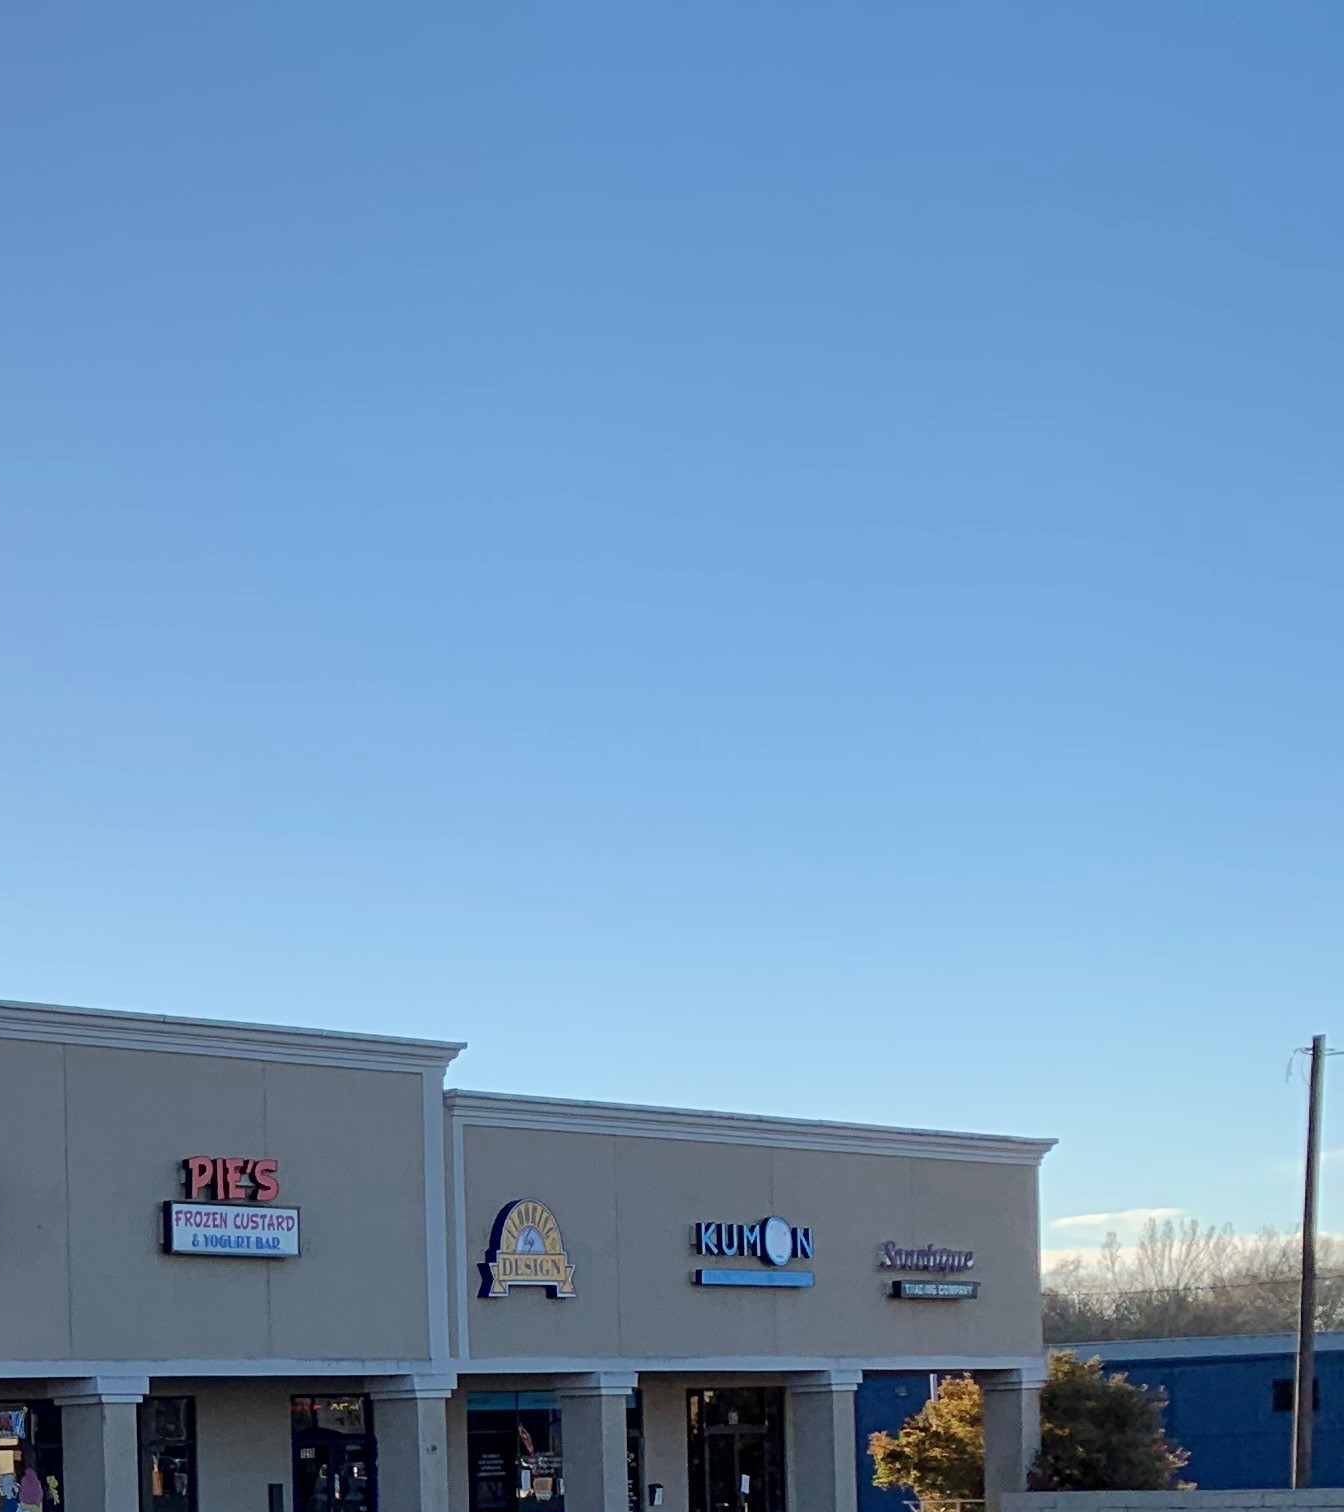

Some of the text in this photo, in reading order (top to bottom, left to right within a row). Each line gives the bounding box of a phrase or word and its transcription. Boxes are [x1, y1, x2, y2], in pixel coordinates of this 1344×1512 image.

[183, 1155, 279, 1200] PIE'S
[175, 1210, 295, 1232] FROZEN CUSTARD
[203, 1234, 252, 1249] YOGURT
[255, 1236, 281, 1250] BAR
[502, 1257, 561, 1277] DESIGN
